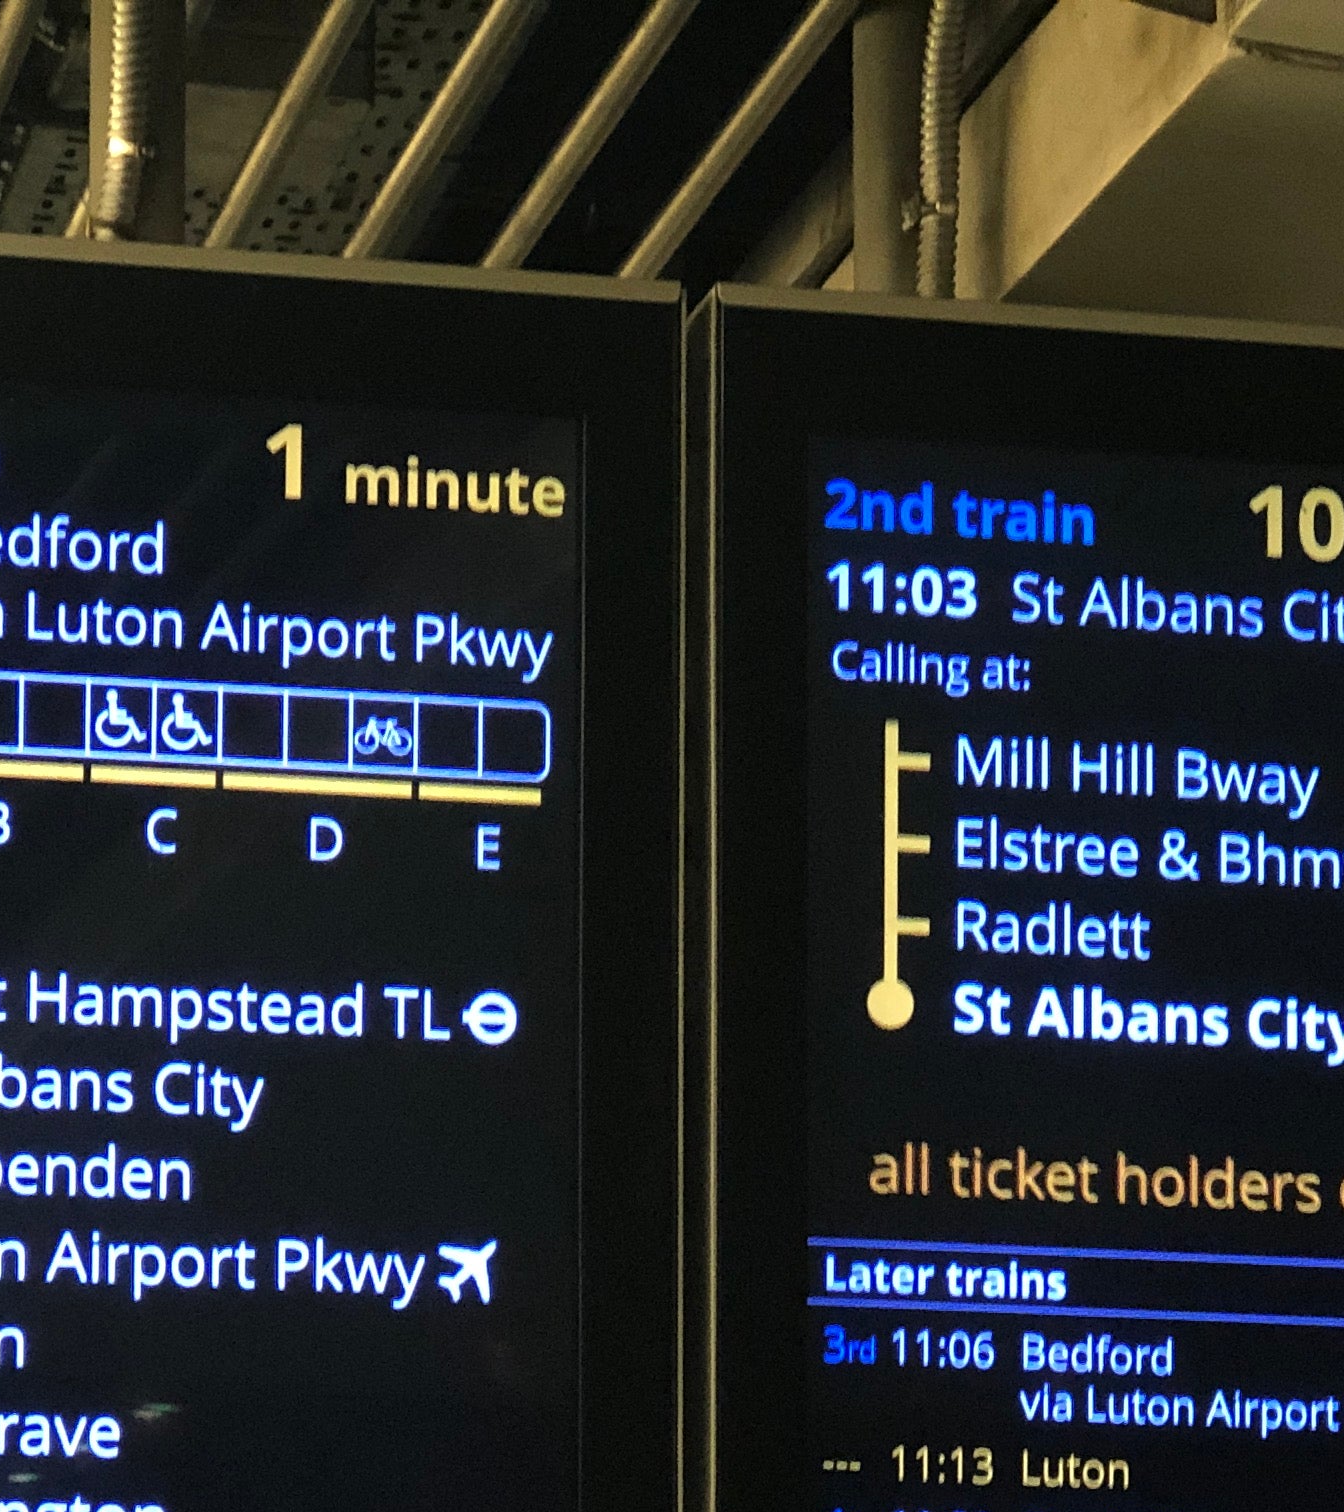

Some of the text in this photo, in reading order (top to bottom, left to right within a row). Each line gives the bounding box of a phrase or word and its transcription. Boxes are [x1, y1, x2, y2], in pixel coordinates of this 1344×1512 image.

[266, 424, 565, 517] 1 minute
[824, 477, 1096, 546] 2nd train
[825, 558, 979, 620] 11:03
[1011, 569, 1065, 626] St
[1078, 574, 1265, 639] Albans
[26, 589, 186, 650] Luton
[199, 600, 397, 670] Airport
[415, 611, 554, 684] Pkwy
[830, 639, 1031, 698] Calling at:
[957, 733, 1320, 821] Mill Hill Bway
[144, 806, 178, 855] C
[307, 813, 345, 862] D
[476, 822, 501, 872] E
[956, 814, 1141, 878] Elstree
[1158, 827, 1201, 882] &
[956, 897, 1151, 962] Radlett
[25, 968, 366, 1045] Hampstead
[382, 983, 451, 1042] TL
[952, 979, 1013, 1036] St
[1026, 983, 1231, 1048] Albans
[151, 1058, 265, 1133] City
[869, 1142, 930, 1196] all
[949, 1147, 1098, 1204] ticket
[1117, 1151, 1322, 1214] holders
[43, 1228, 257, 1303] Airport
[274, 1234, 427, 1311] Pkwy
[824, 1252, 1067, 1302] Later trains
[823, 1323, 1174, 1377] 3rd 11:06 Bedford
[1019, 1381, 1075, 1423] via
[1087, 1384, 1195, 1427] Luton
[1205, 1388, 1341, 1440] Airport
[892, 1444, 994, 1486] 11:13
[1022, 1448, 1129, 1490] Luton
